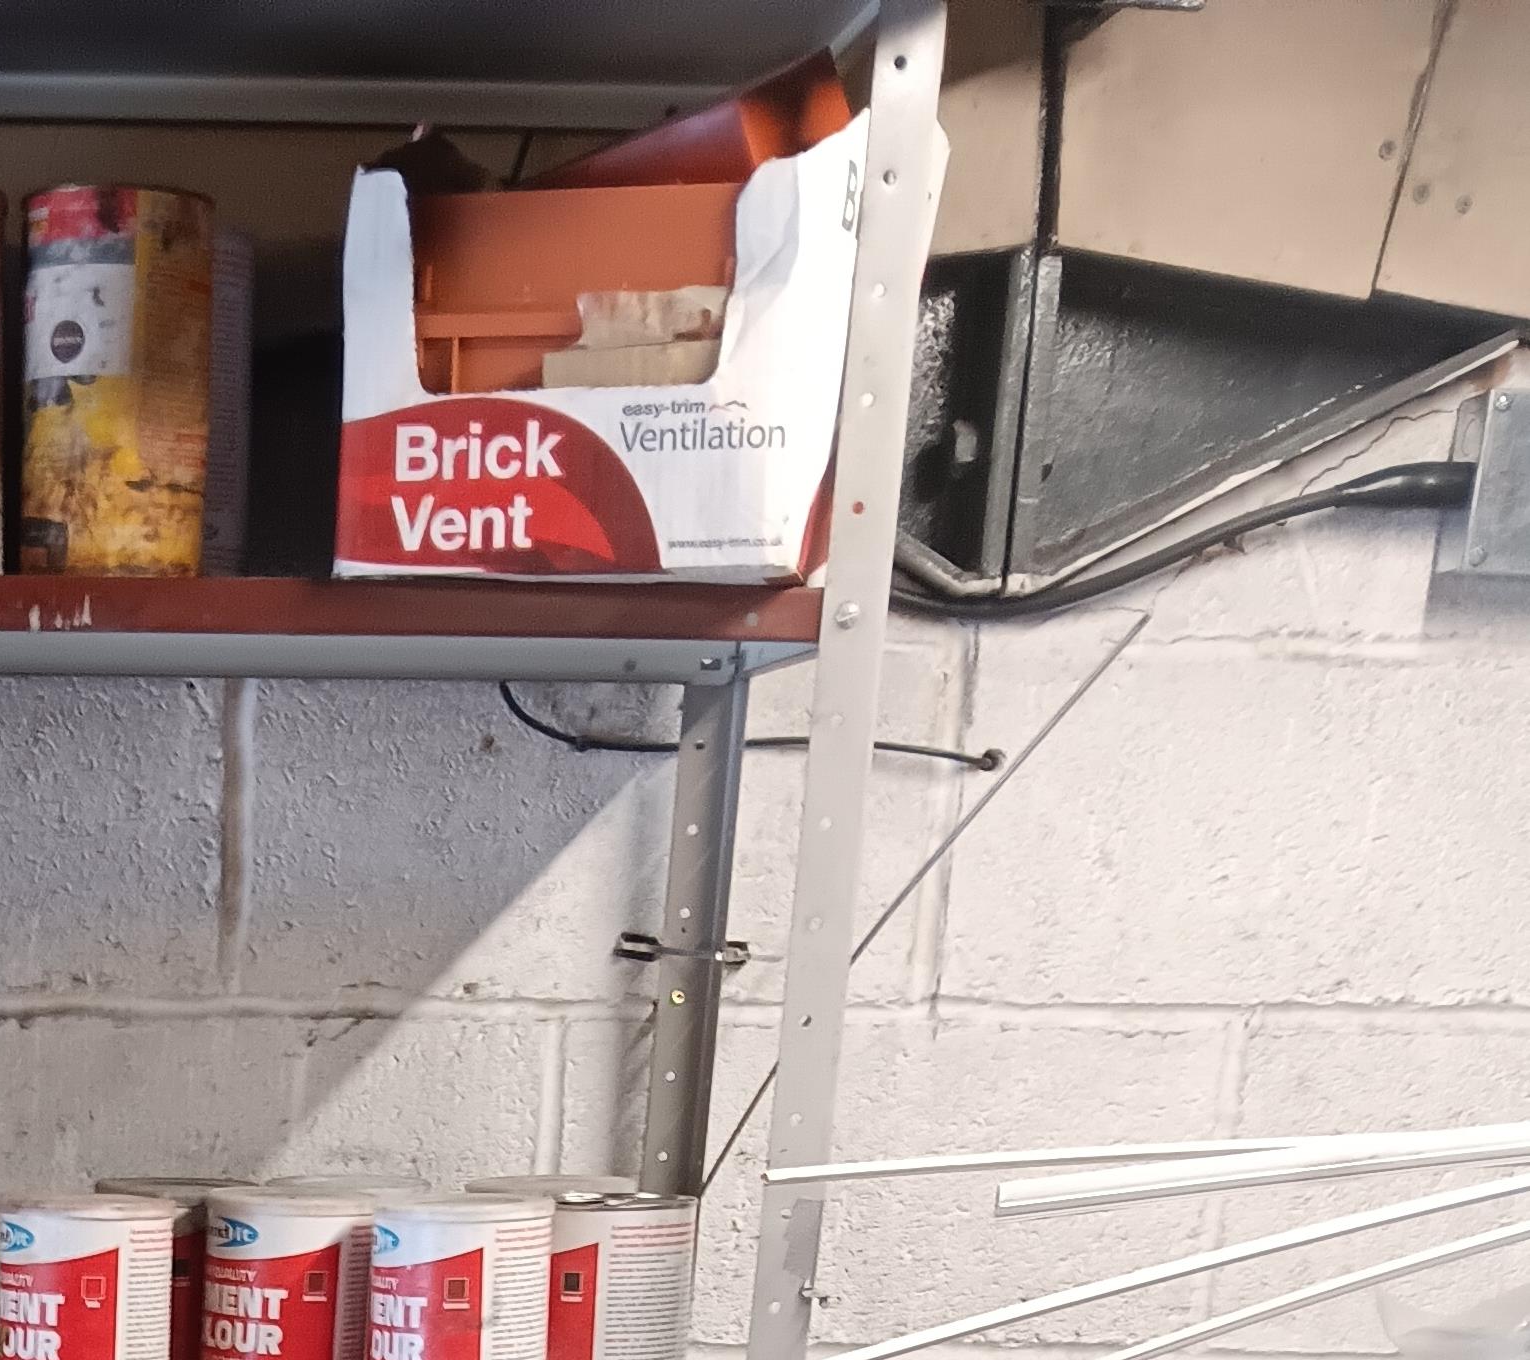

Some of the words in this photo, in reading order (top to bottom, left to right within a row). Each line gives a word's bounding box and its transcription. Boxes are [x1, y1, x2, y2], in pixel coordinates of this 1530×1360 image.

[623, 400, 706, 417] easy-trim
[394, 419, 564, 484] Brick
[620, 417, 785, 452] Ventilation
[391, 493, 533, 552] Vent
